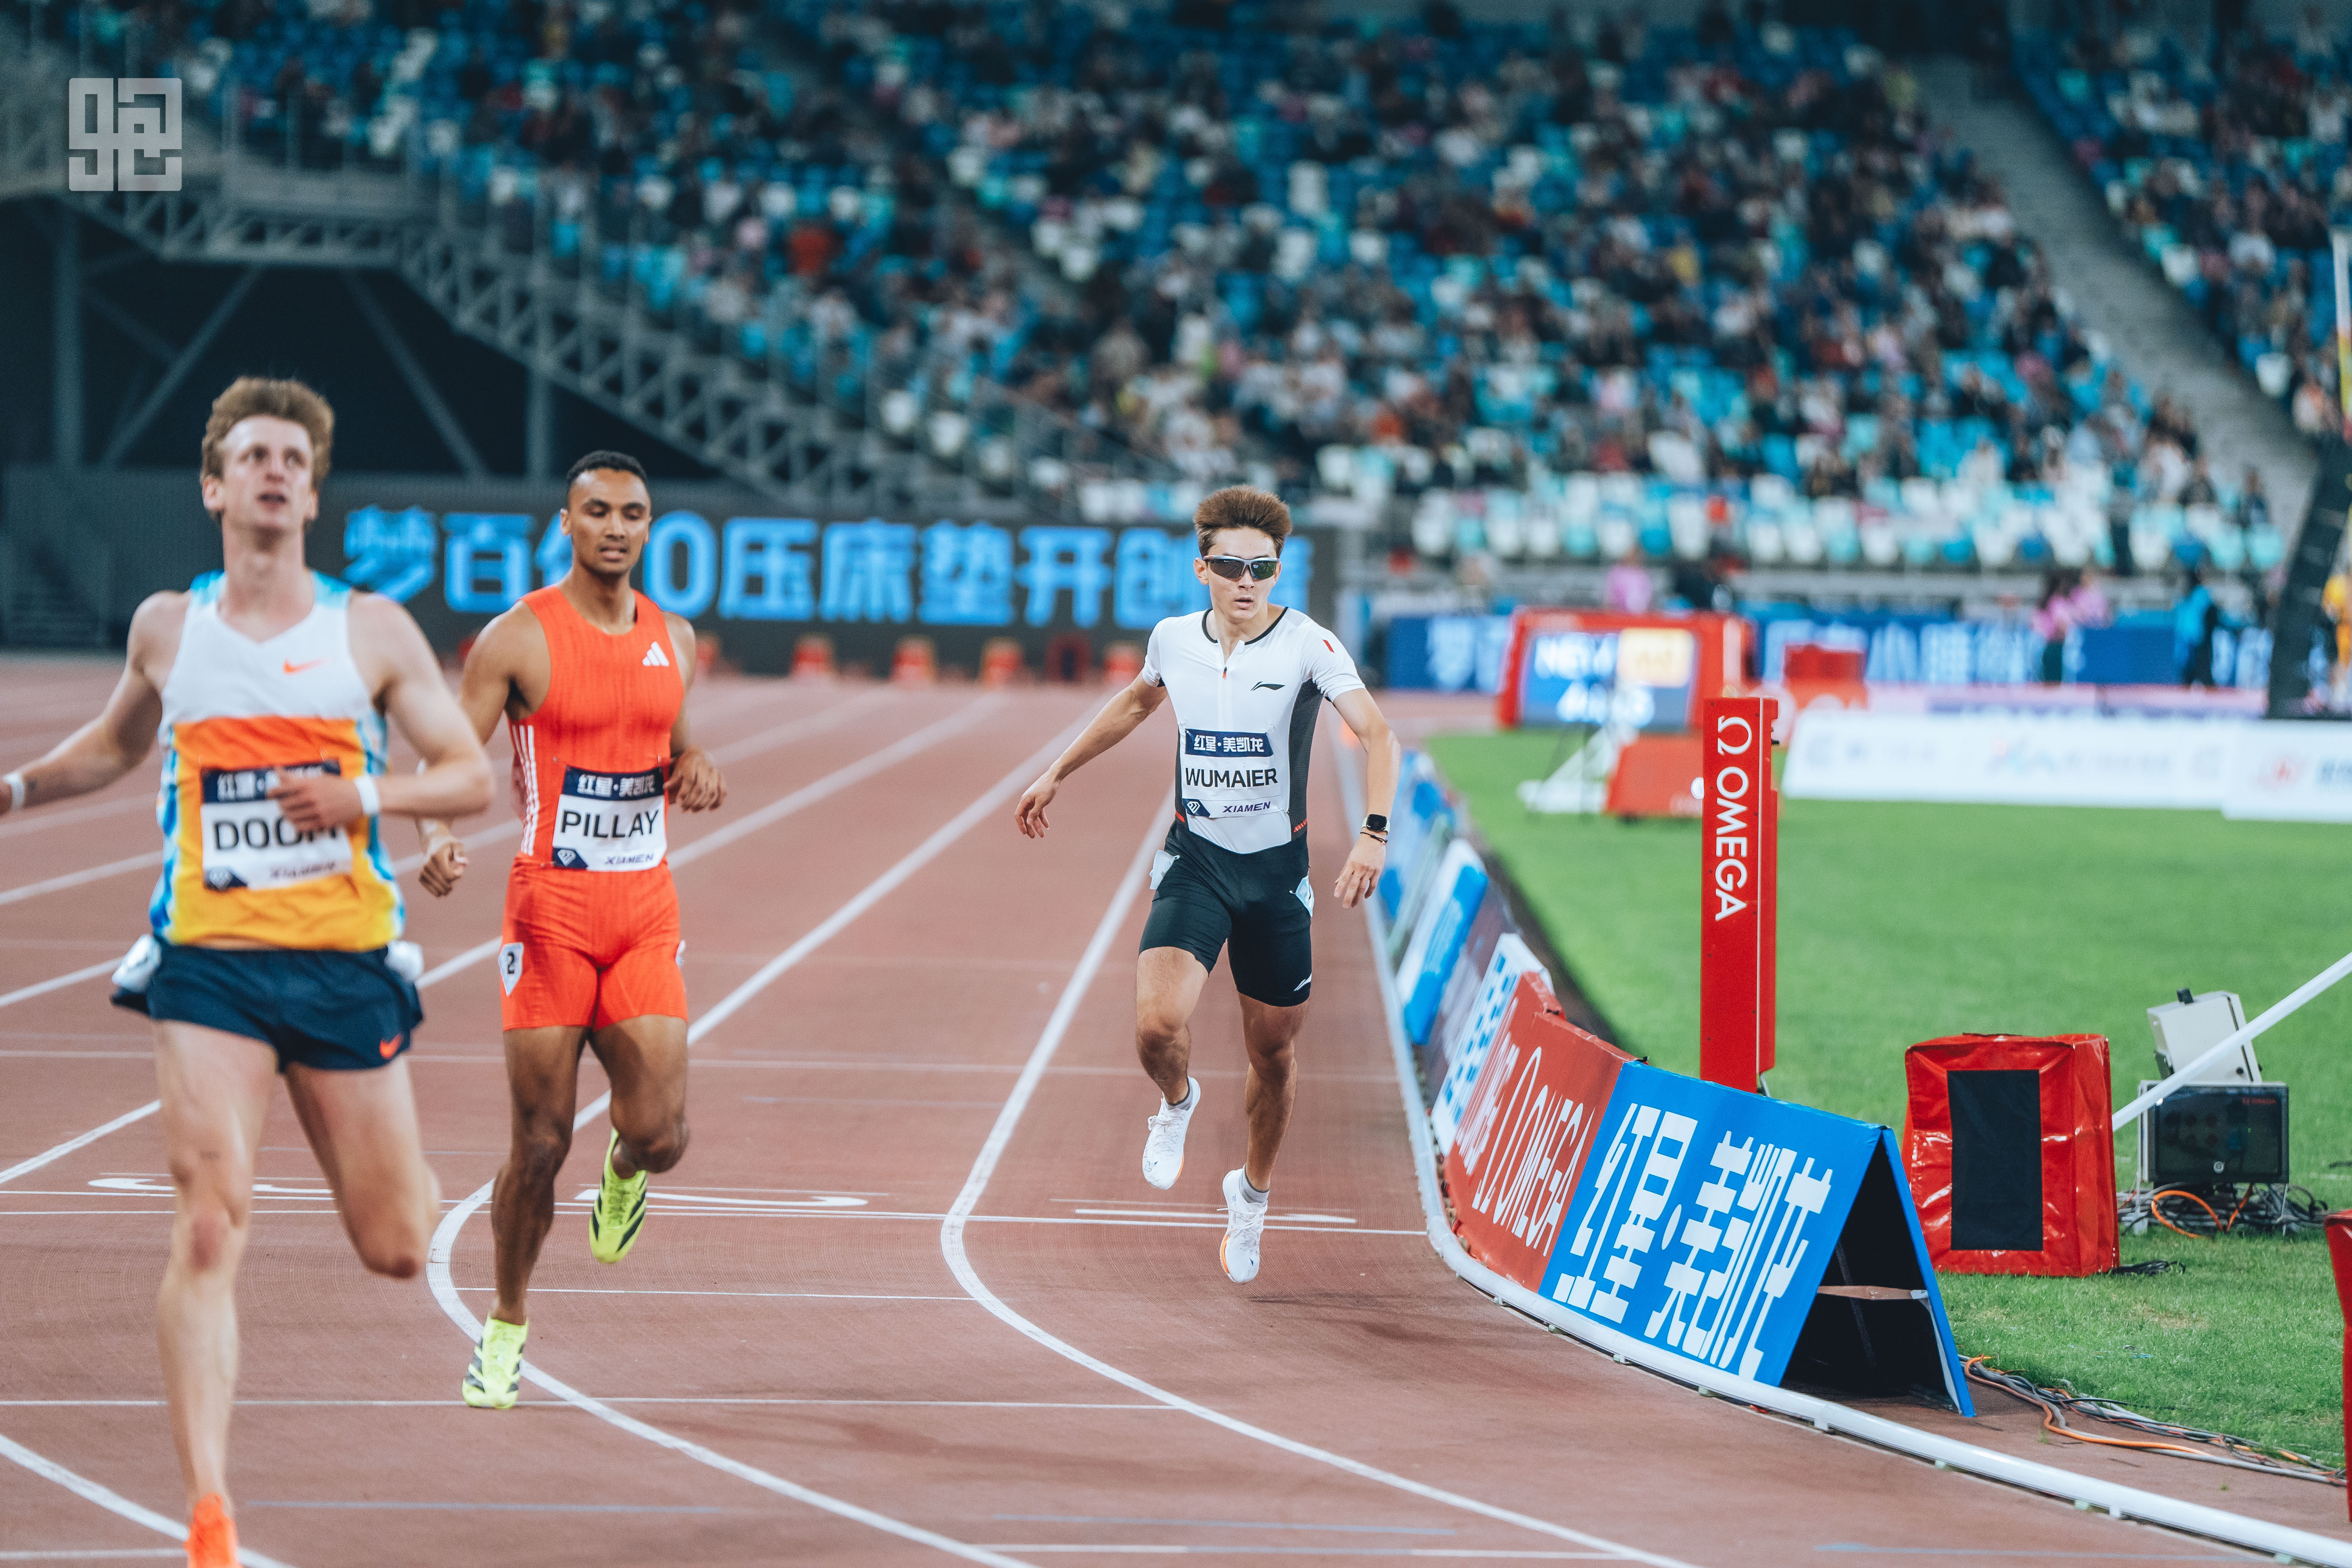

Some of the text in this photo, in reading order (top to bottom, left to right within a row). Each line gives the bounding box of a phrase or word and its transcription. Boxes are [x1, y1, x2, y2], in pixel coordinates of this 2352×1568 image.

[343, 503, 1311, 628] 梦百0压床垫开创
[1193, 734, 1264, 753] 红星·美凯龙
[1185, 767, 1278, 788] WUMAIER
[1222, 801, 1271, 813] XIAMEN
[561, 809, 659, 838] PILLAY
[1715, 766, 1749, 922] OMEGA
[605, 853, 654, 865] XIAMEN
[506, 952, 515, 974] 2
[1493, 1084, 1595, 1257] OMEGA
[1552, 1102, 1833, 1381] 红星·美凯龙
